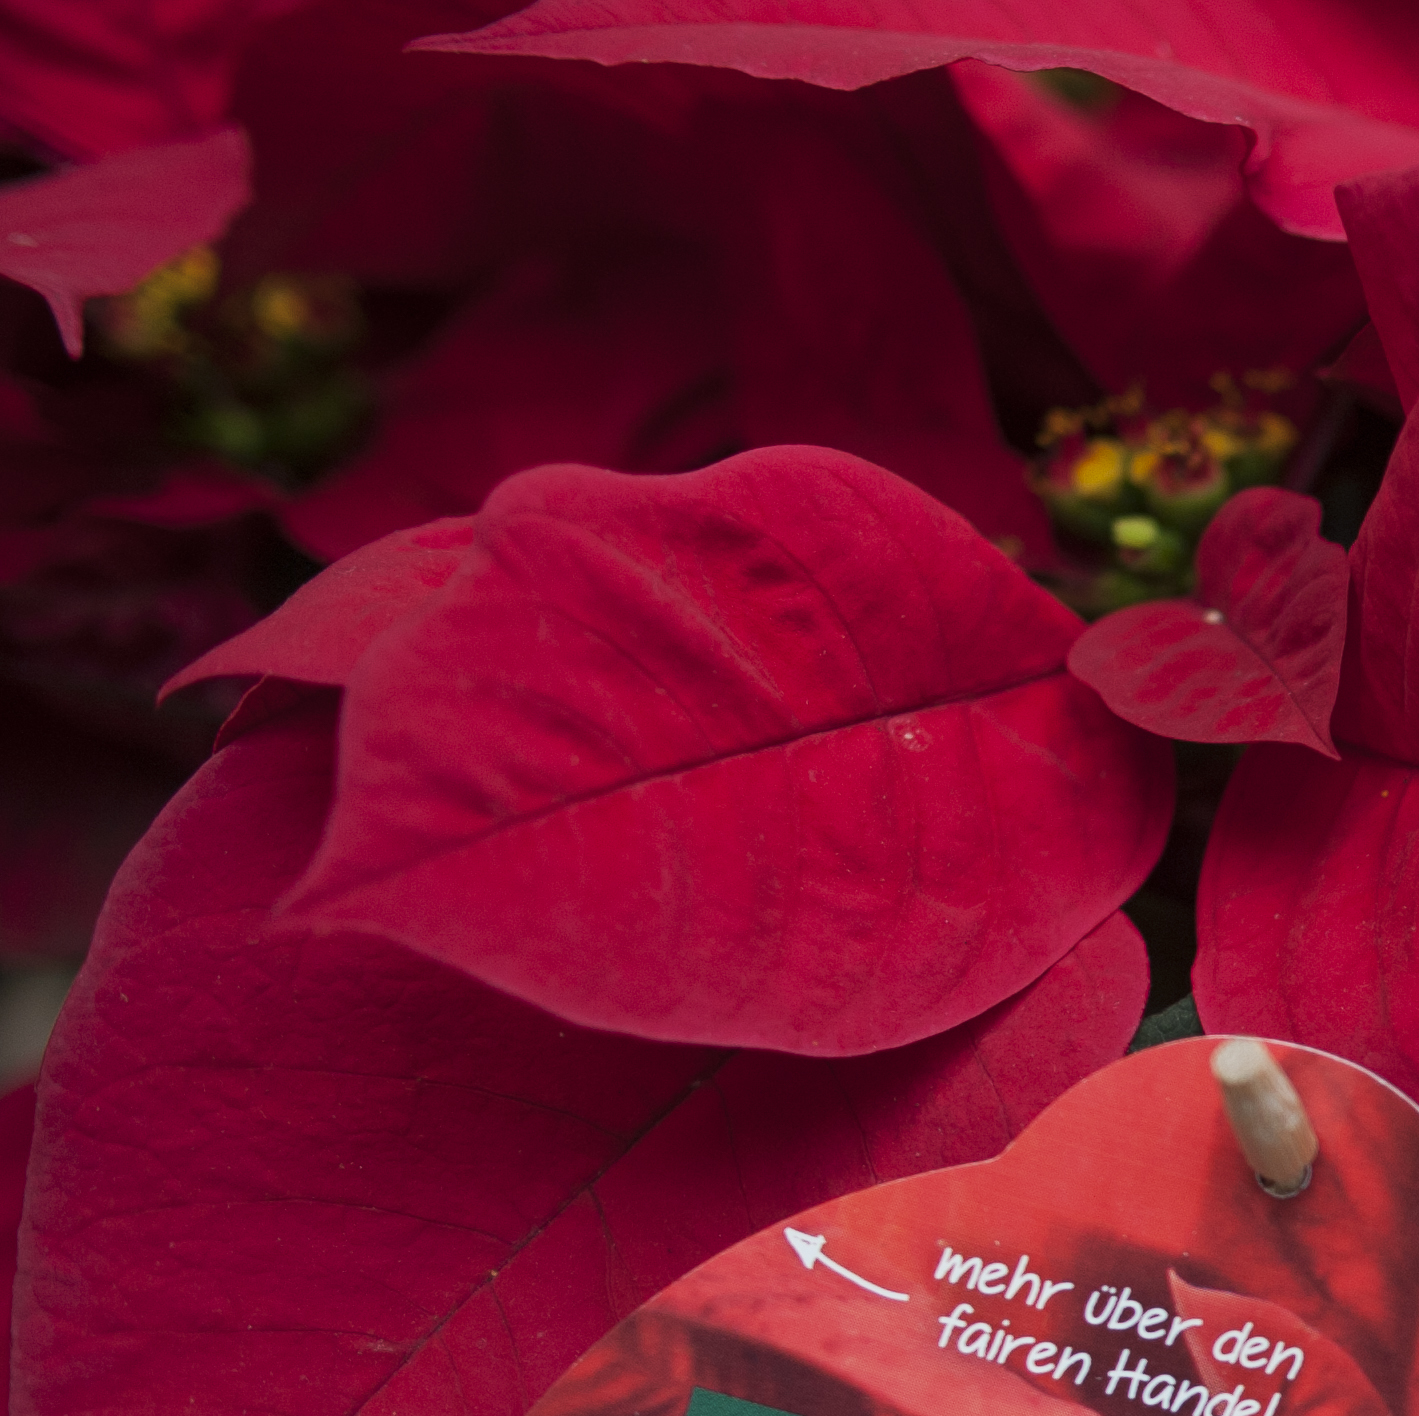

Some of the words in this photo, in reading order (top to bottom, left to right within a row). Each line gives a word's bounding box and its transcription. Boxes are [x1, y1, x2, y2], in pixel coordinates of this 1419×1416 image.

[934, 1246, 1074, 1309] mehr
[1084, 1285, 1203, 1347] über
[1212, 1321, 1304, 1380] den
[937, 1303, 1091, 1385] fairen
